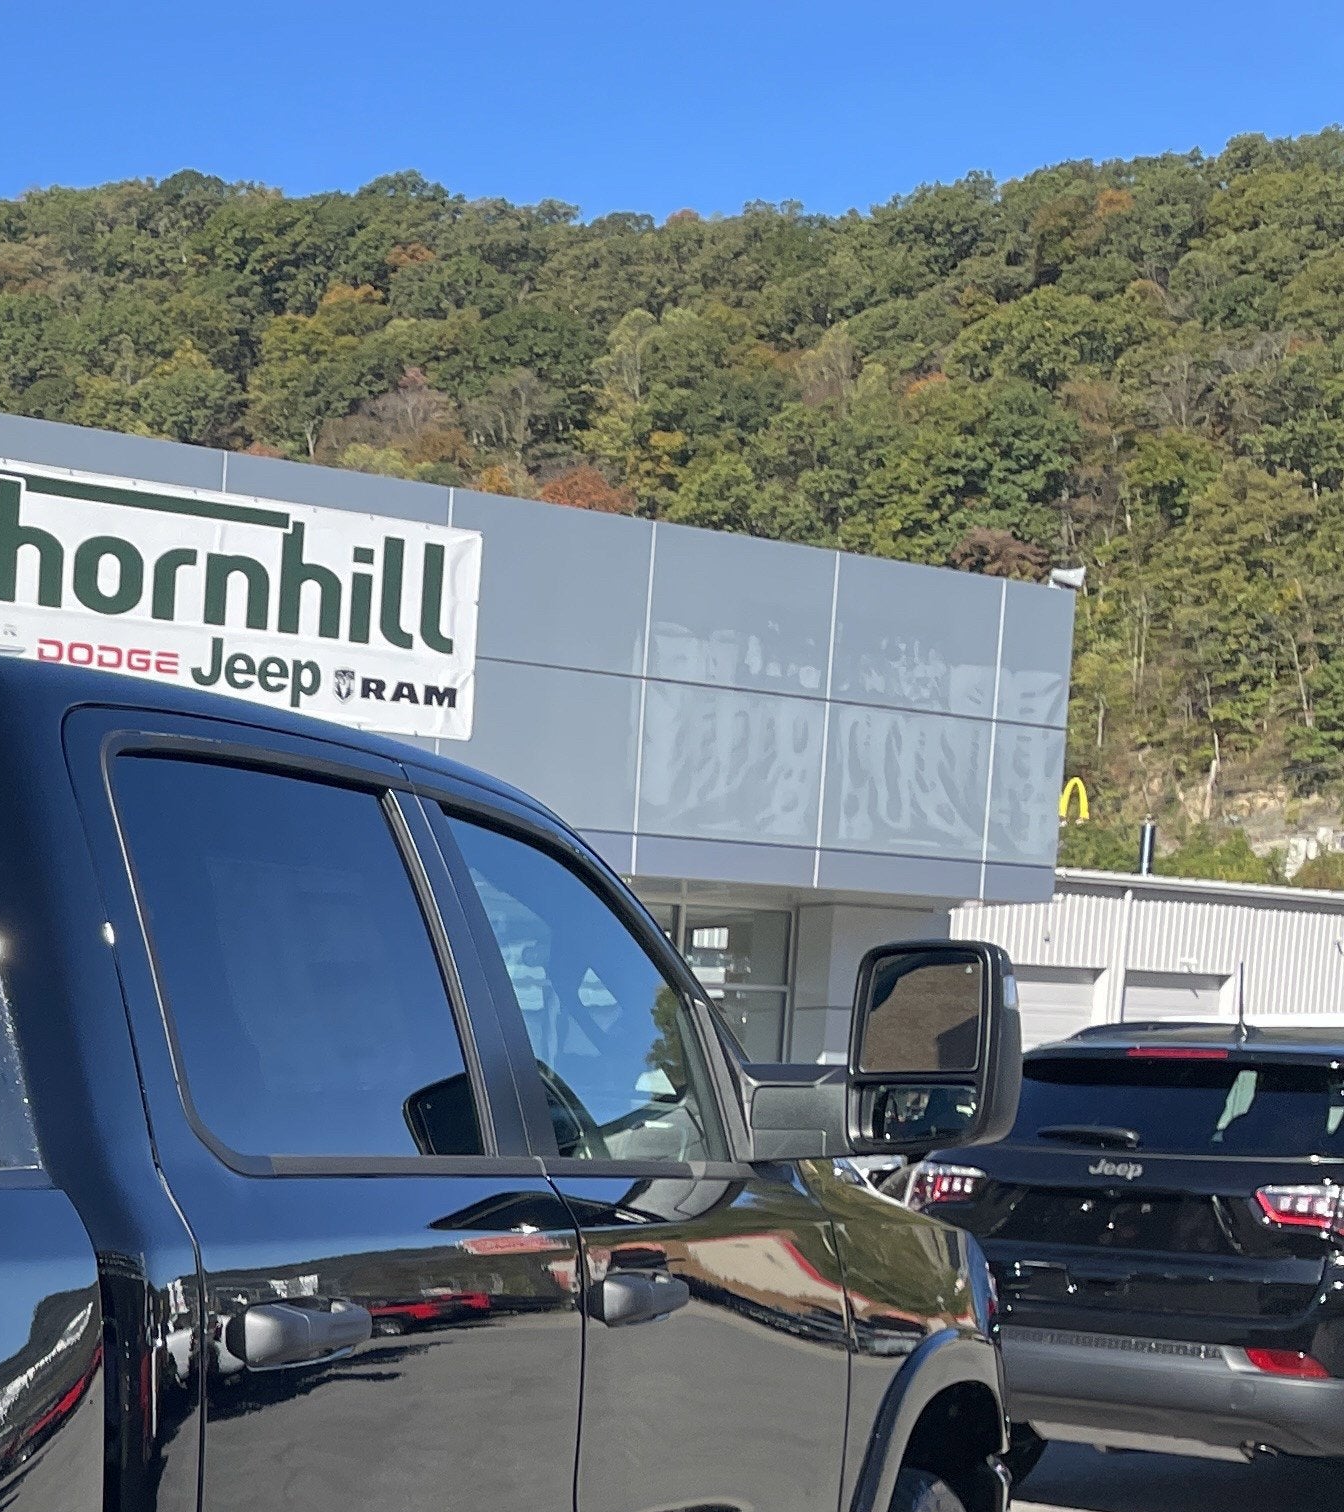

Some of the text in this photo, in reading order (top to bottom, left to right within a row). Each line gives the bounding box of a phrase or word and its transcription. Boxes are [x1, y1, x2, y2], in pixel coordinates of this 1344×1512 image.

[37, 638, 180, 675] DODGE
[191, 636, 321, 708] Jeep
[360, 677, 457, 709] RAM
[1088, 1158, 1143, 1181] Jeep
